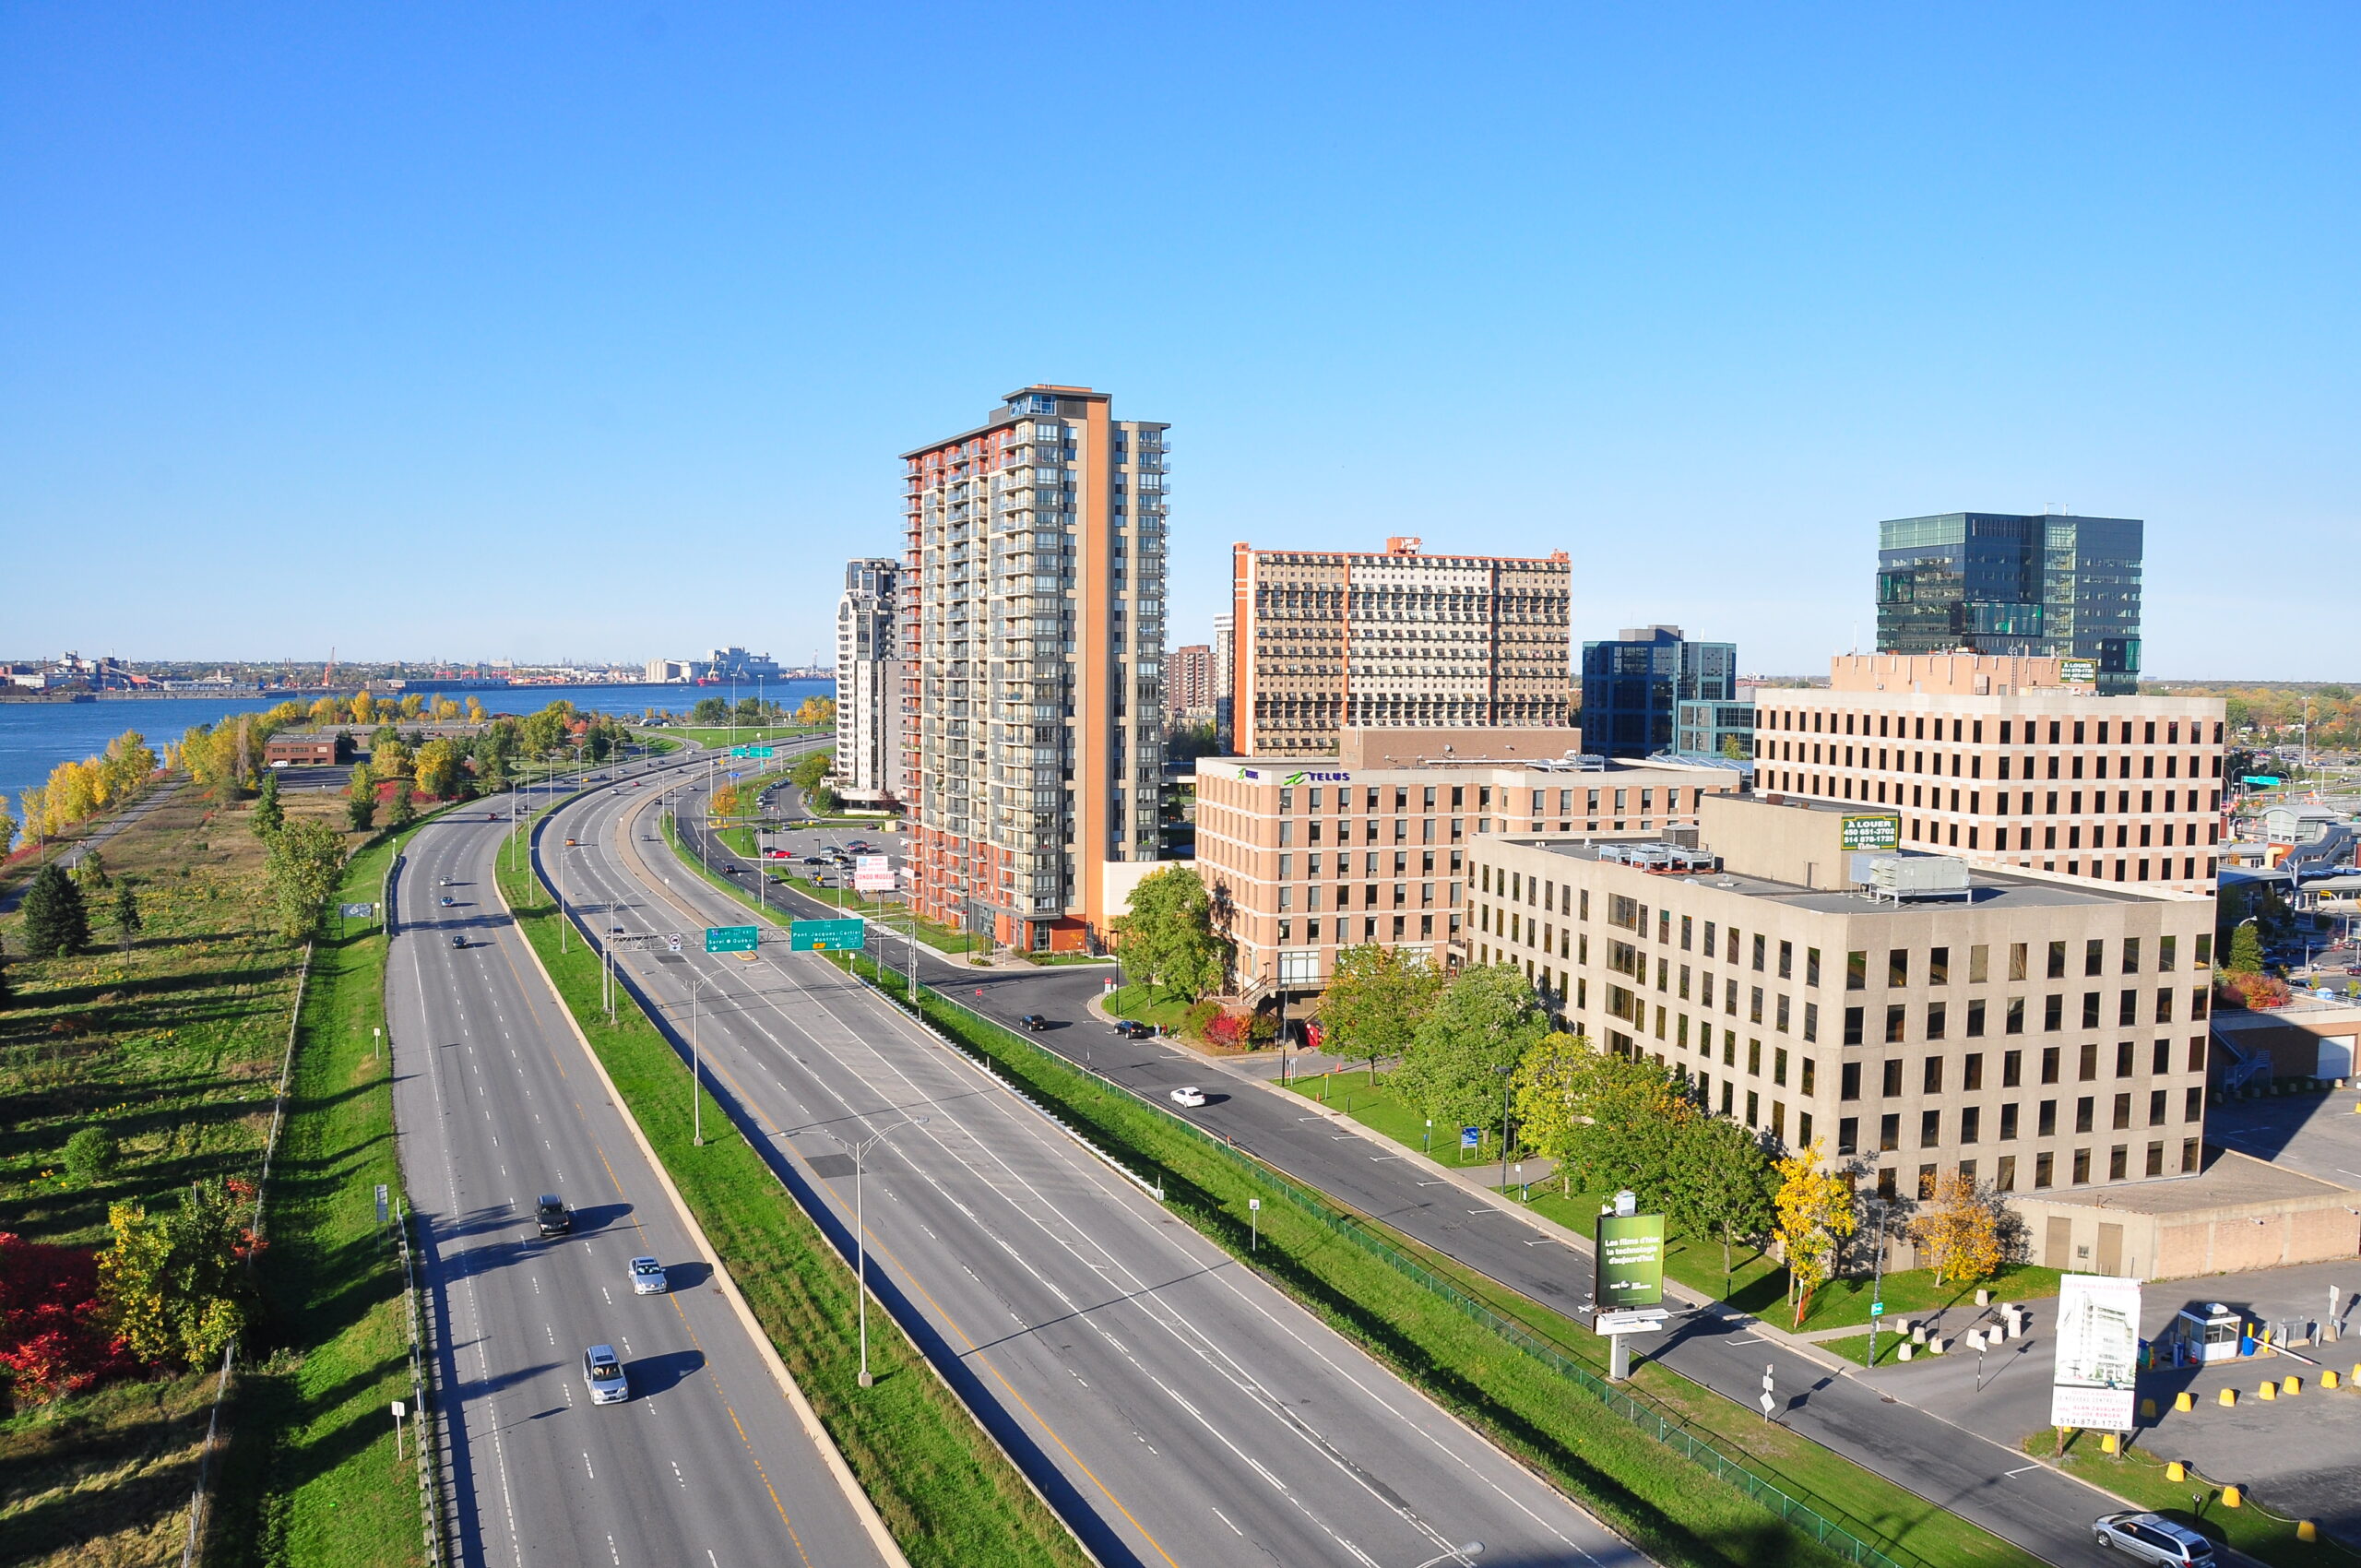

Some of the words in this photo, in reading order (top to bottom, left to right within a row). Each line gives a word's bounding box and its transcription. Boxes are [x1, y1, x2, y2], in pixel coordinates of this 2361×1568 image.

[1310, 772, 1350, 781] TELUS
[1857, 820, 1892, 828] LOUER
[1859, 827, 1895, 836] 651-3702
[1859, 835, 1895, 843] 878-1725
[1605, 1239, 1619, 1247] Les
[1615, 1245, 1658, 1255] technologie
[2059, 1418, 2124, 1428] 514-878-1725
